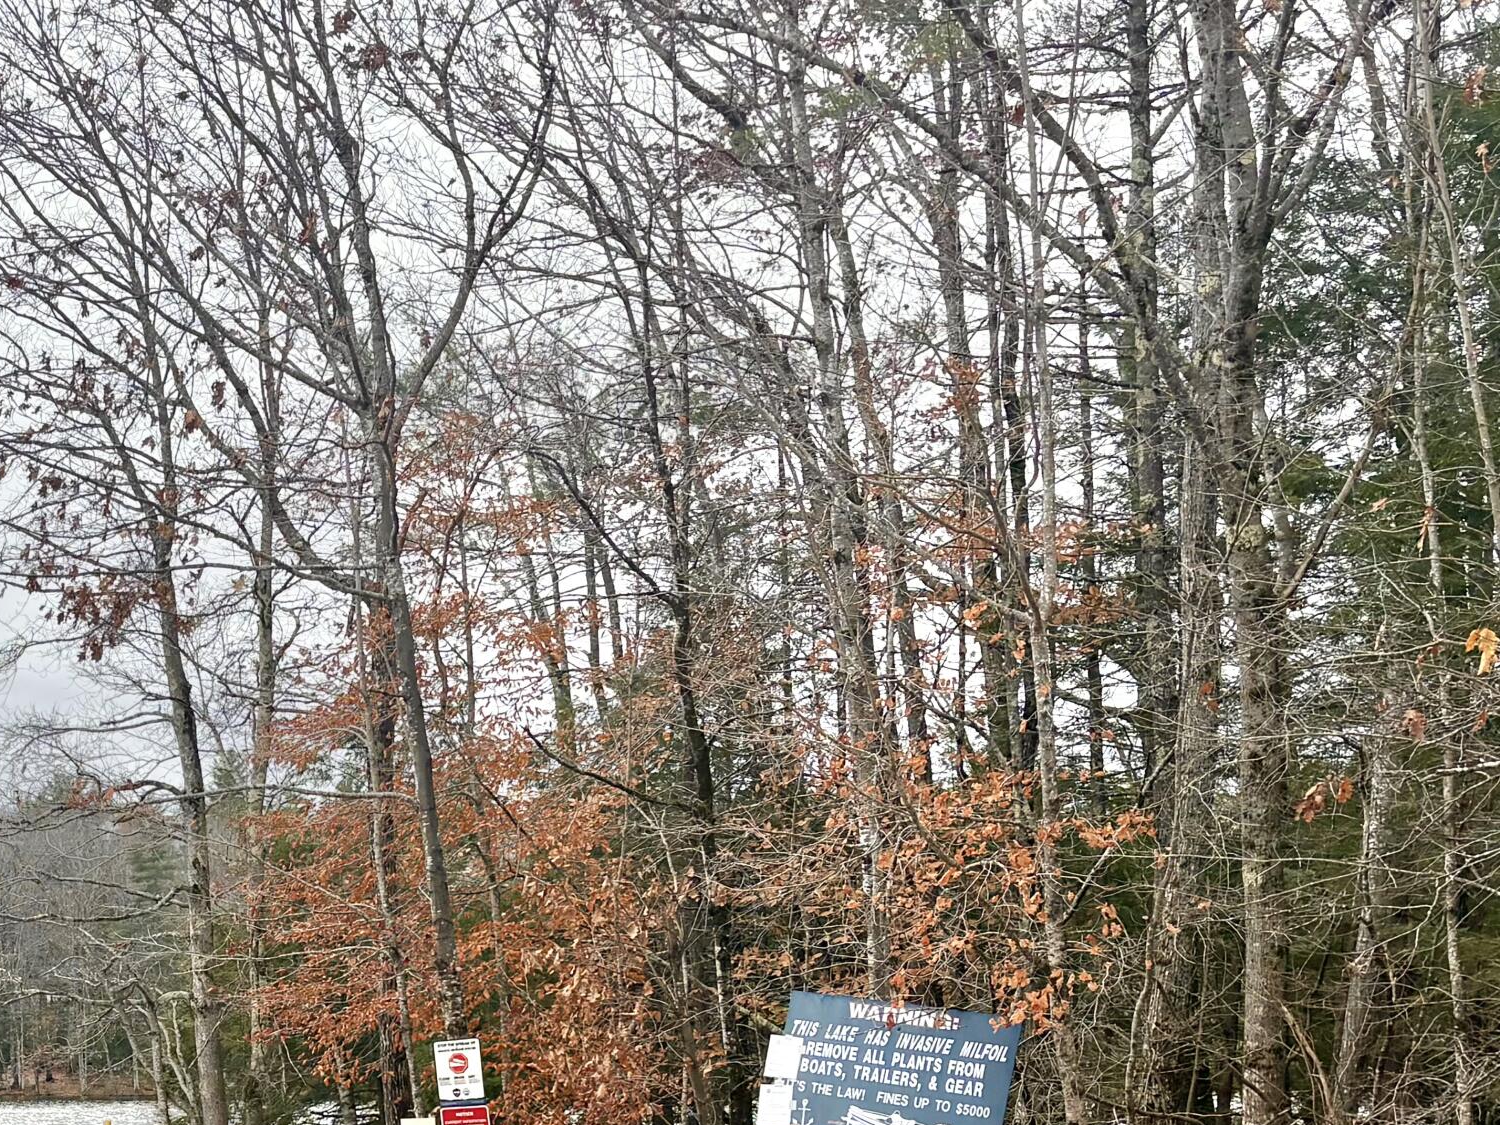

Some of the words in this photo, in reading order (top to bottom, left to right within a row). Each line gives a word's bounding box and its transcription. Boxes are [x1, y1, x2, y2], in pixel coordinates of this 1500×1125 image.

[791, 1019, 820, 1037] THIS
[824, 1023, 860, 1042] LAKE
[863, 1029, 891, 1047] HAS
[895, 1032, 955, 1055] INVASIVE
[959, 1041, 1009, 1063] MILFOIL
[805, 1040, 859, 1061] REMOVE
[863, 1048, 886, 1066] ALL
[891, 1052, 943, 1073] PLANTS
[946, 1059, 986, 1079] FROM
[799, 1057, 846, 1081] BOATS,
[853, 1064, 922, 1092] TRAILERS,
[928, 1075, 938, 1091] &
[945, 1077, 984, 1098] GEAR
[811, 1081, 834, 1096] THE
[836, 1085, 866, 1101] LAW!
[875, 1090, 910, 1107] FINES
[913, 1096, 930, 1109] UP
[935, 1099, 951, 1113] TO
[955, 1102, 991, 1118] $5000
